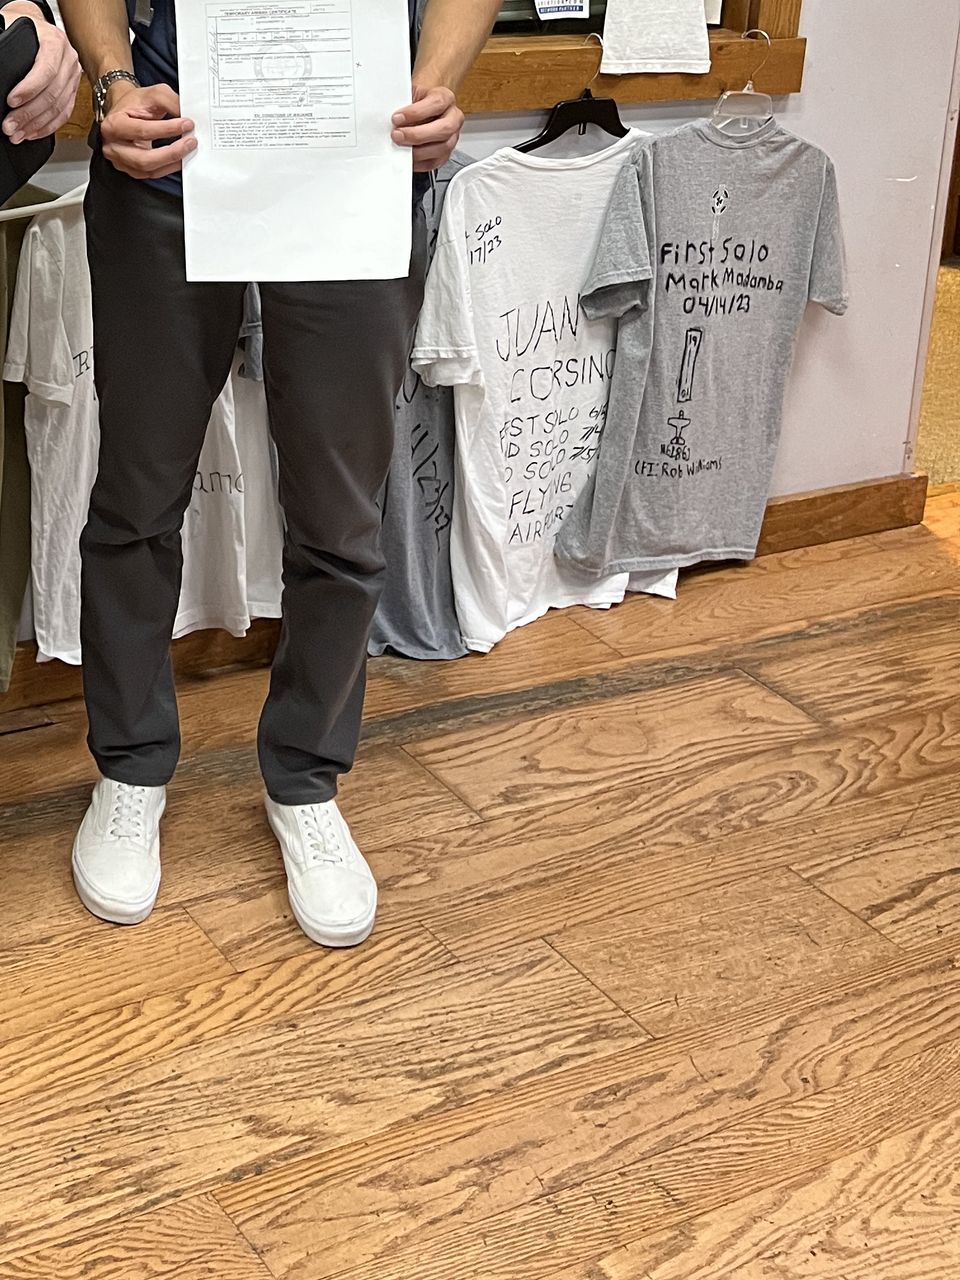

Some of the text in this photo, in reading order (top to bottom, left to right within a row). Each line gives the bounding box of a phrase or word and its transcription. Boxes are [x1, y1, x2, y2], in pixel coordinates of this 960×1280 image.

[476, 215, 503, 241] SOLO
[660, 236, 769, 265] First Solo
[665, 272, 719, 293] Mark
[683, 293, 751, 317] 04/14/23
[496, 292, 581, 362] JUAN
